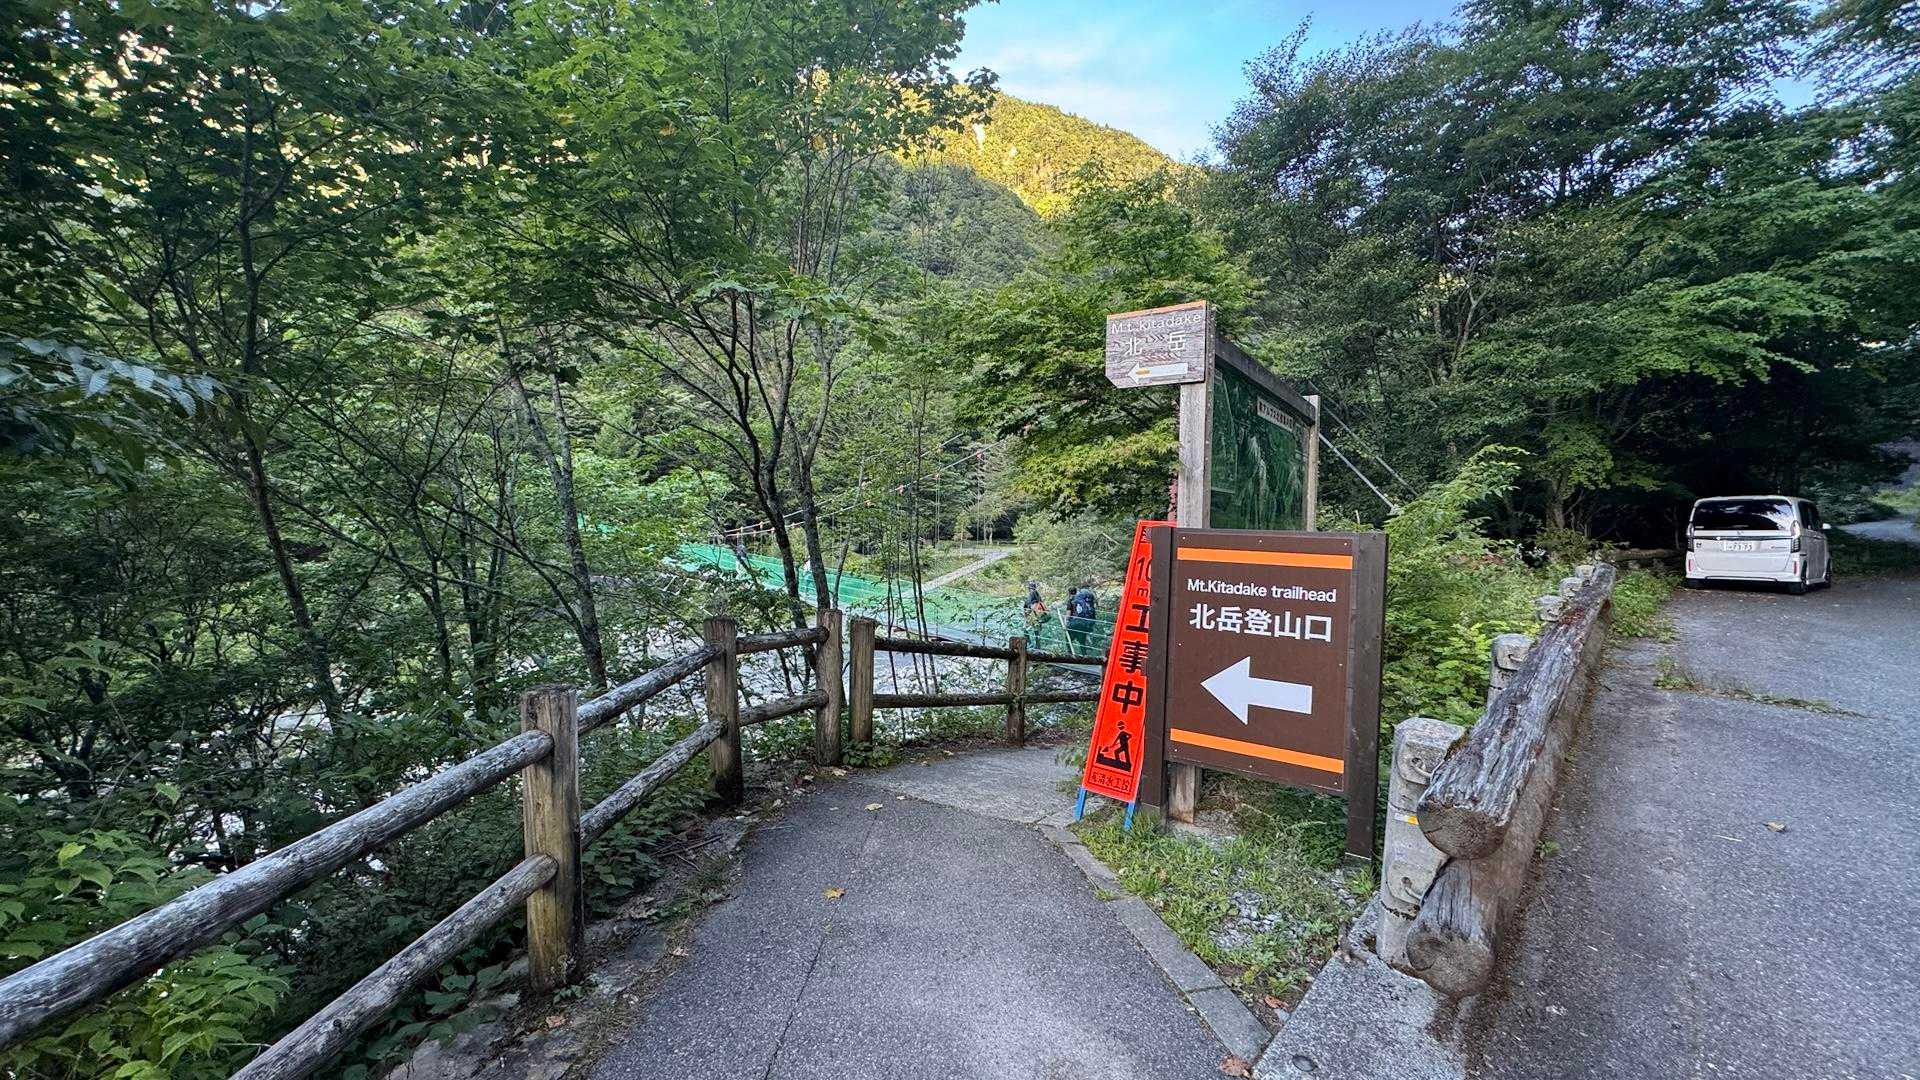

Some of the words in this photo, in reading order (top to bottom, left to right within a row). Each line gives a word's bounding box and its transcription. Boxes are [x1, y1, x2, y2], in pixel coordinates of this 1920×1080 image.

[1187, 578, 1267, 597] Mt.Kitadake
[1271, 585, 1337, 602] trailhead
[1189, 603, 1332, 642] 北岳登山口
[1112, 603, 1150, 714] 工事中
